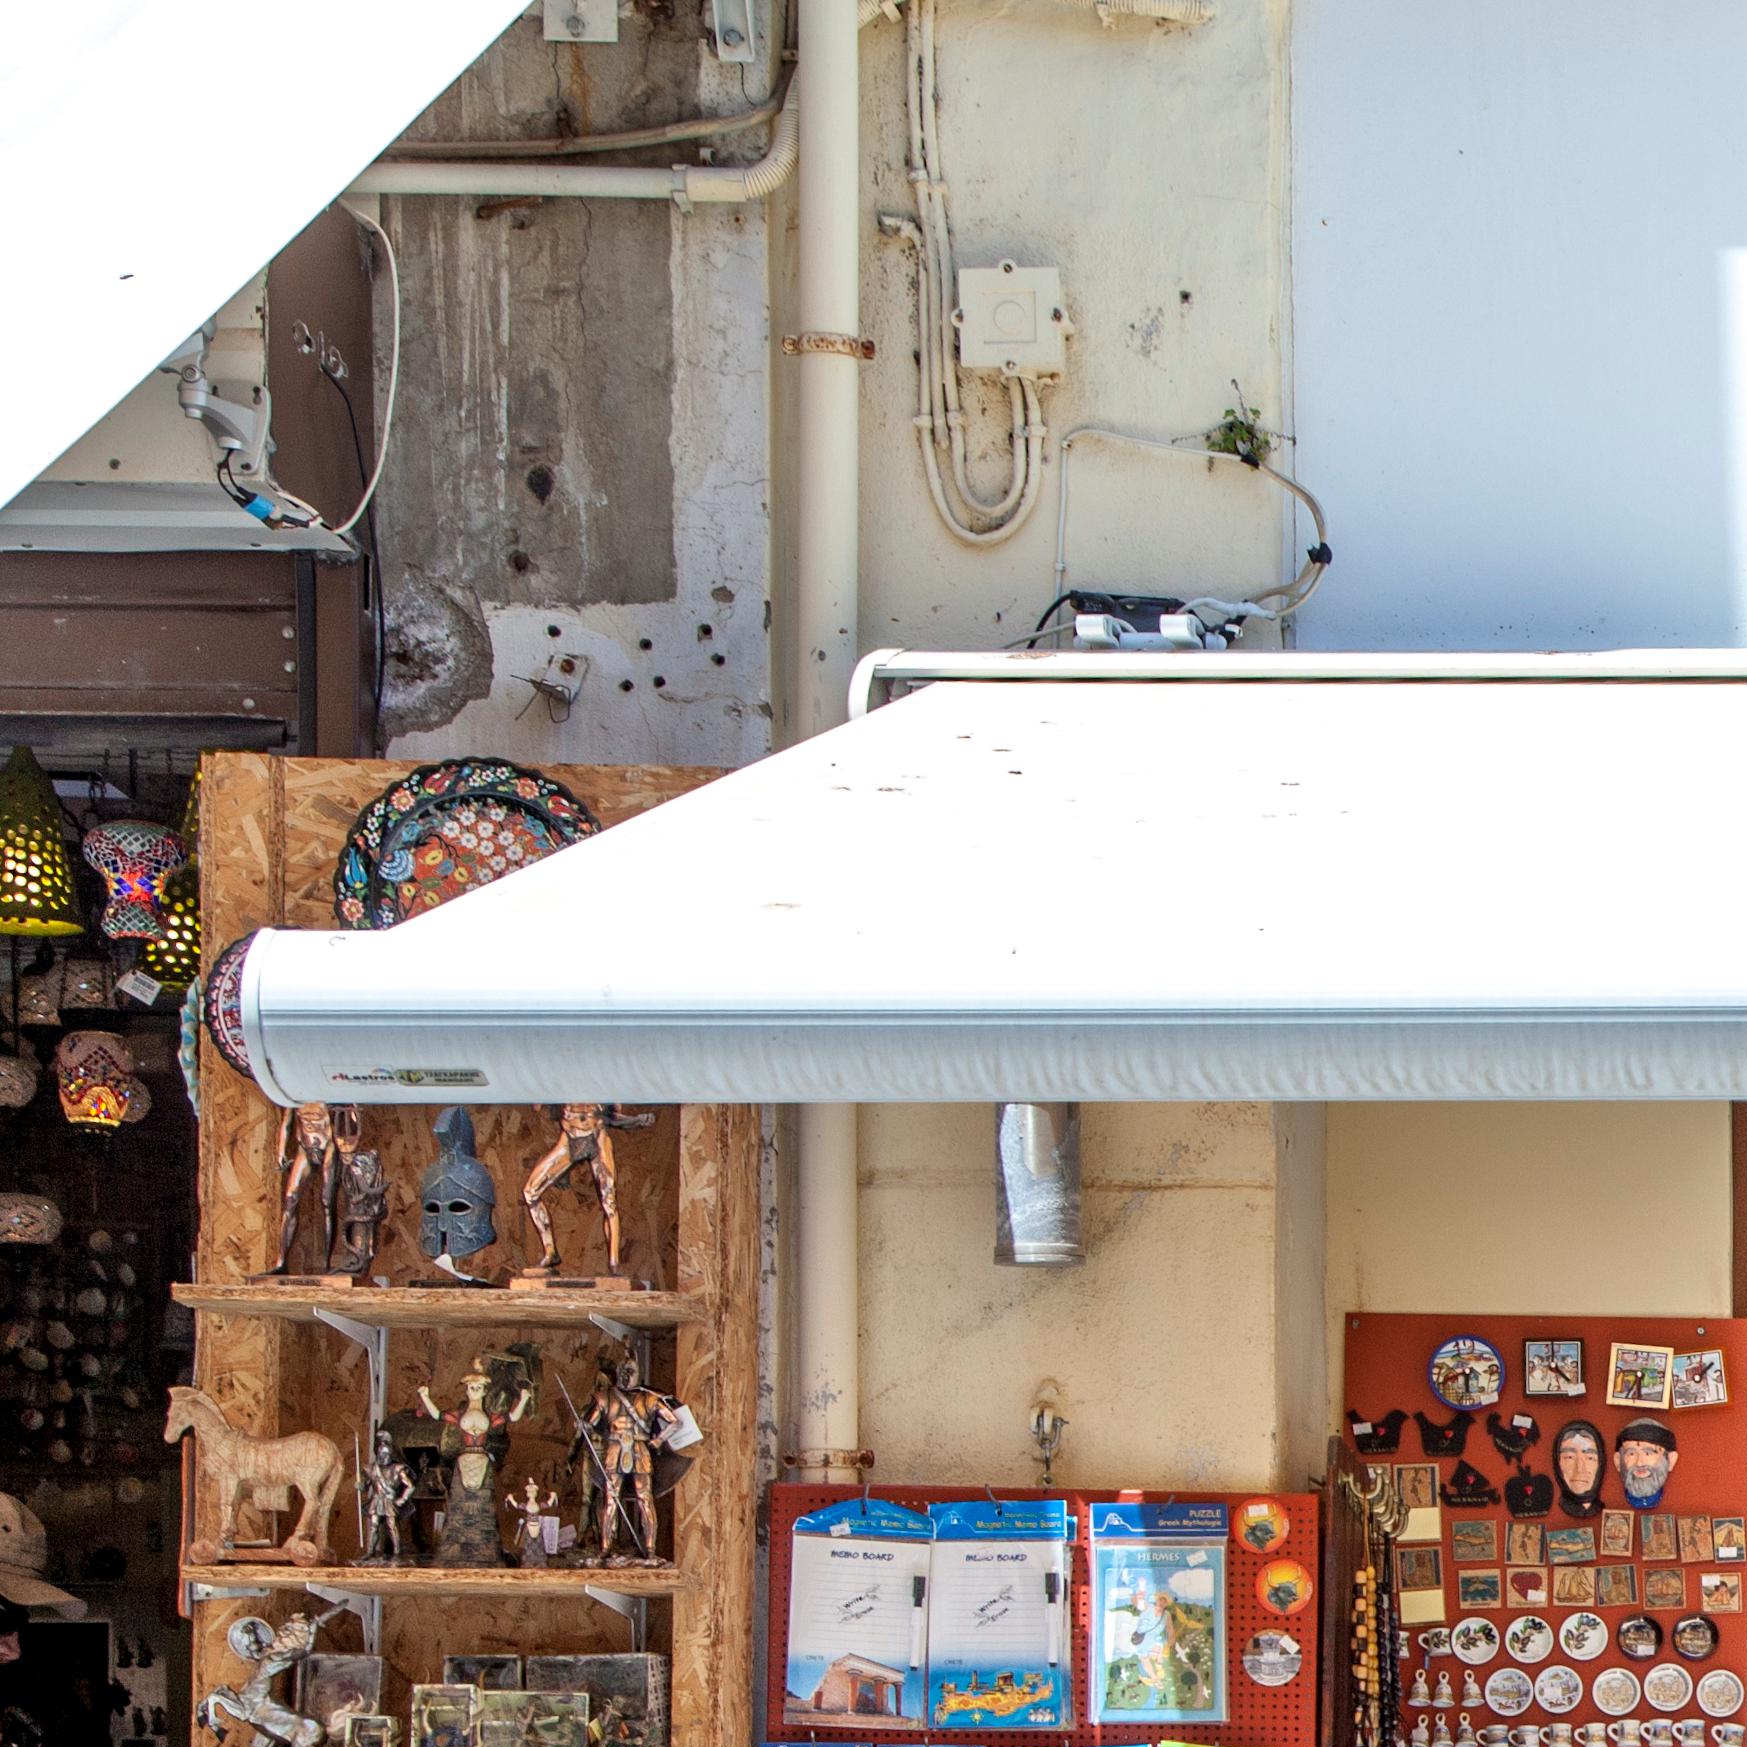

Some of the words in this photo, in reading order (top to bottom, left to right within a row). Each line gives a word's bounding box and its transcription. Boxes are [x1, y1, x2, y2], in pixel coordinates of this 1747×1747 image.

[1040, 1520, 1062, 1529] Board
[831, 1550, 859, 1560] MEMO
[862, 1552, 895, 1562] BOARD
[997, 1553, 1028, 1562] BOARD
[1137, 1552, 1180, 1562] HERMES
